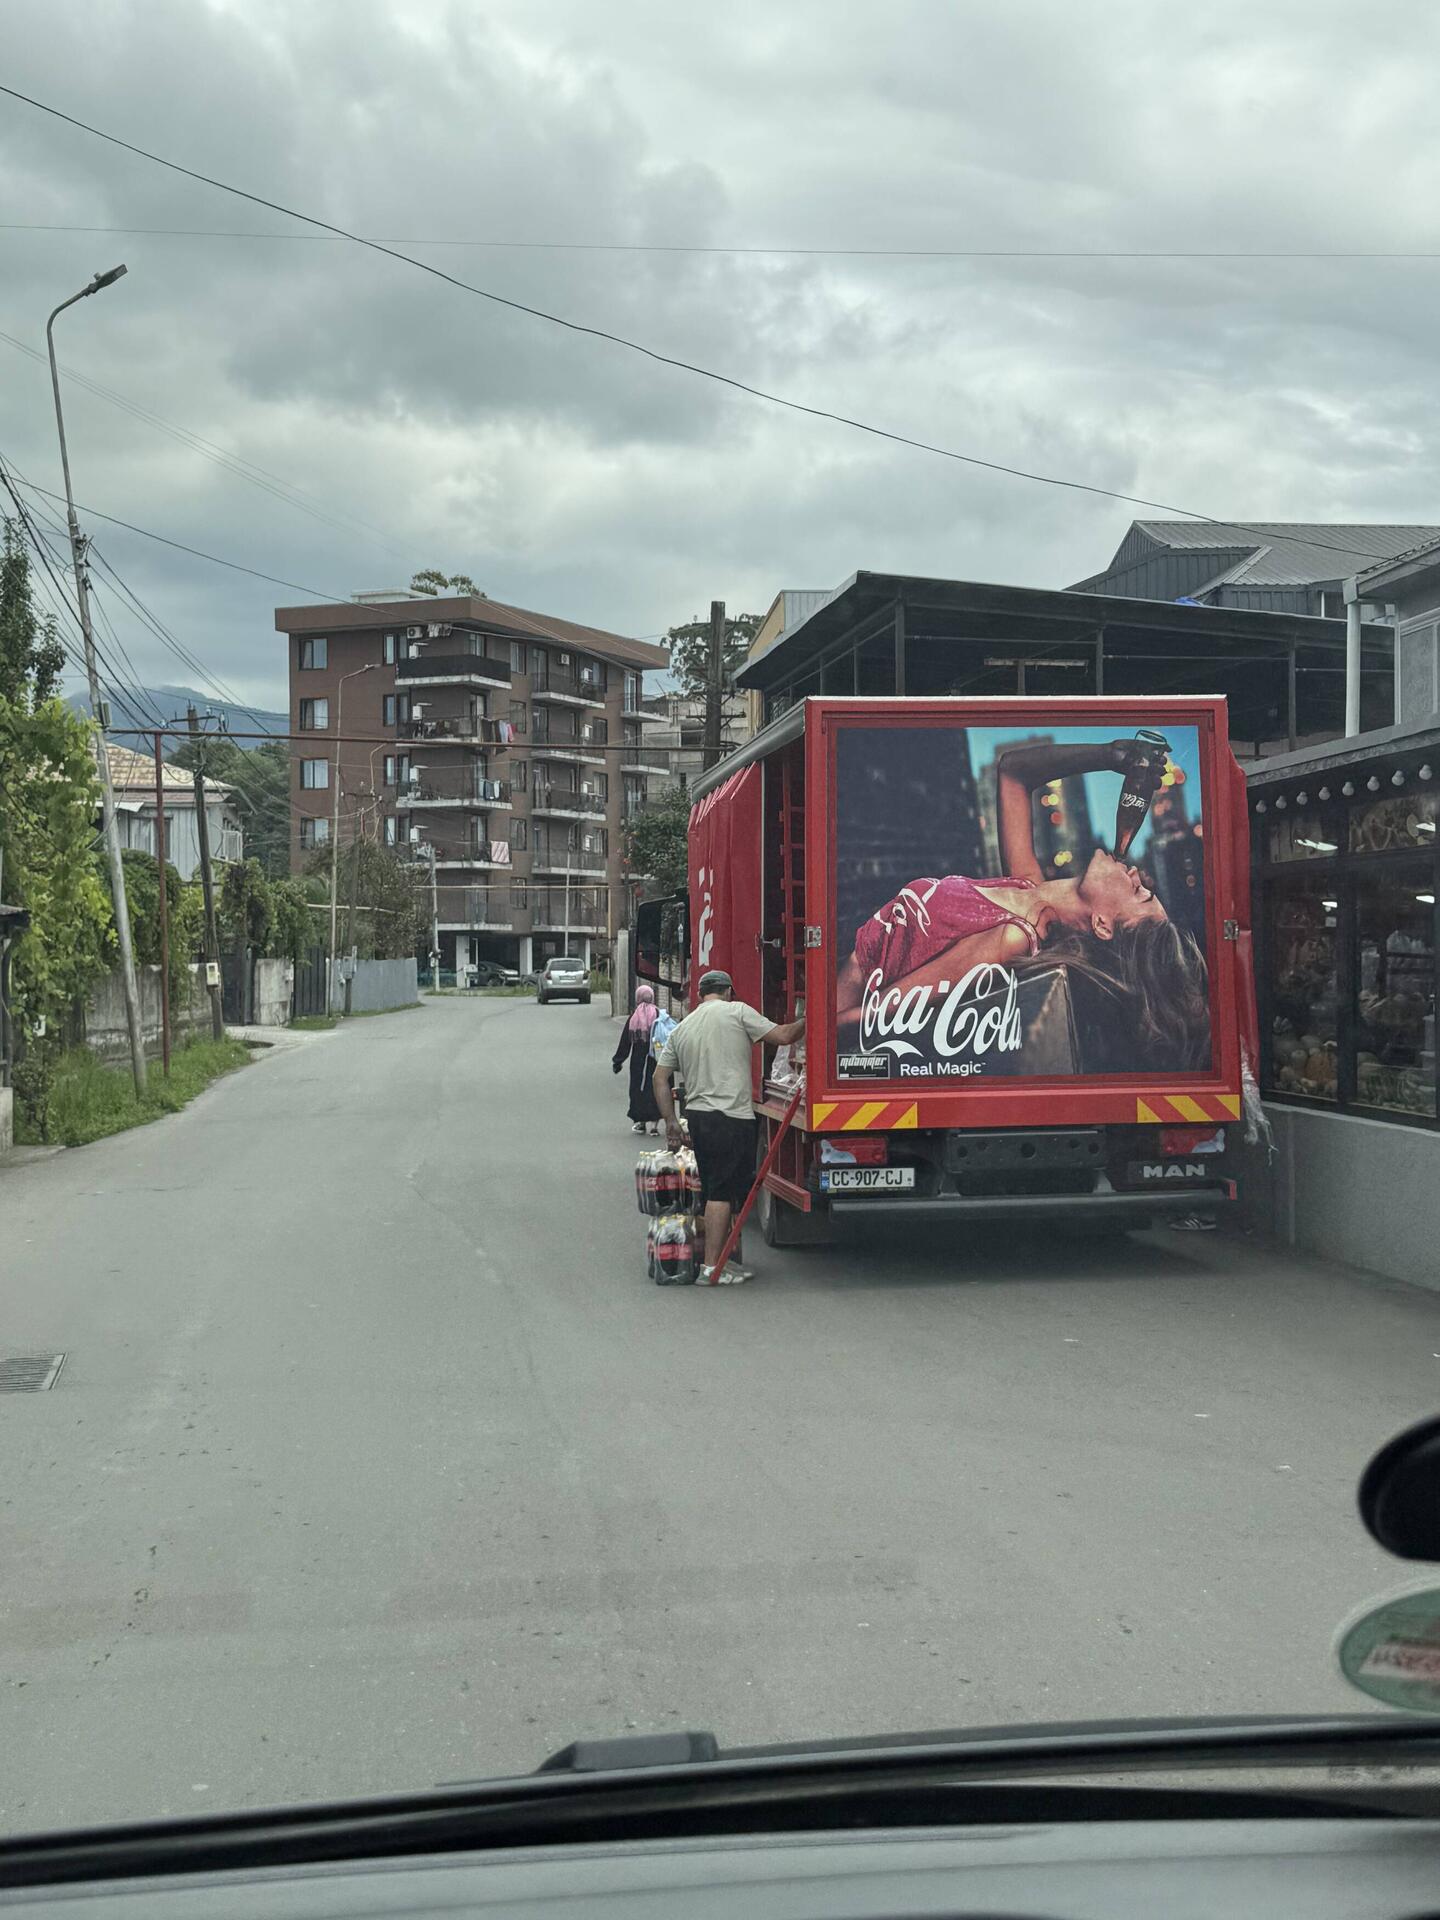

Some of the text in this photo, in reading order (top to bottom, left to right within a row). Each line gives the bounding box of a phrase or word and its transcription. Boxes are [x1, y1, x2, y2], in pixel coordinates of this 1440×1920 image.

[859, 963, 1023, 1058] Coca-Cola
[900, 1061, 982, 1076] Real Magic
[832, 1170, 903, 1187] CC-907-CJ
[1143, 1164, 1205, 1178] MAN
